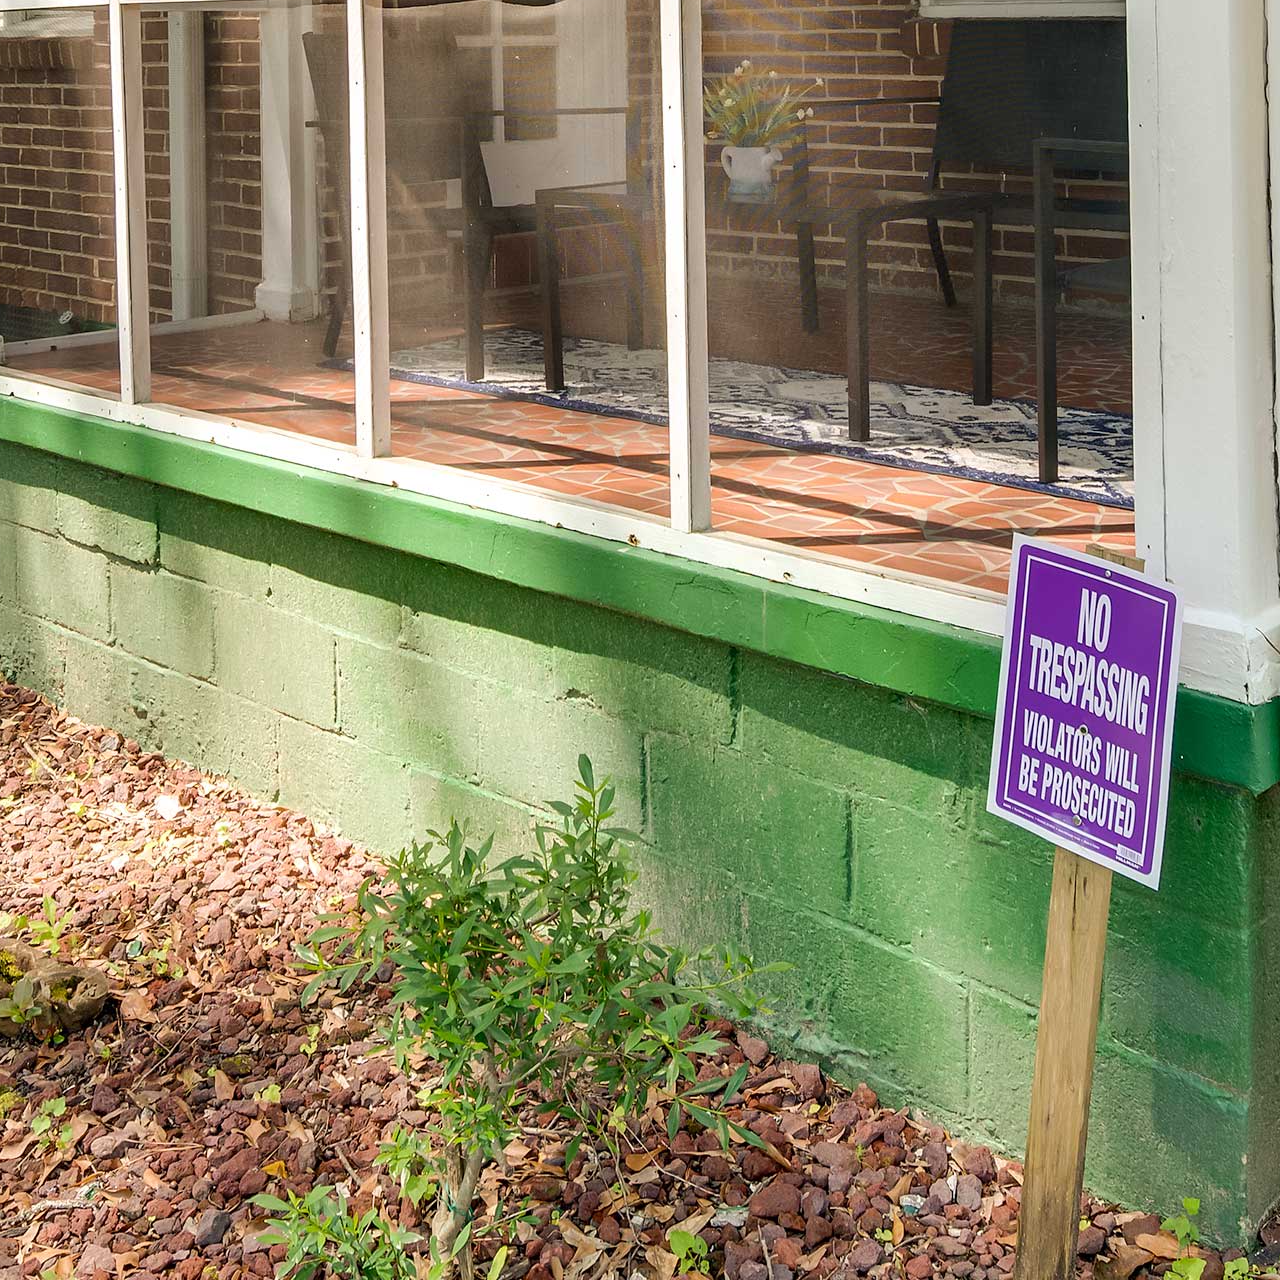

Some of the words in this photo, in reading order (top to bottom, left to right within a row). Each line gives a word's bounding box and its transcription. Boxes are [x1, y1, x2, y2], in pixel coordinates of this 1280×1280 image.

[1078, 588, 1112, 653] NO
[1029, 635, 1150, 736] TRESPASSING
[1023, 709, 1101, 776] VIOLATORS
[1105, 740, 1139, 794] WILL
[1019, 756, 1038, 796] BE
[1041, 765, 1136, 839] PROSECUTED
